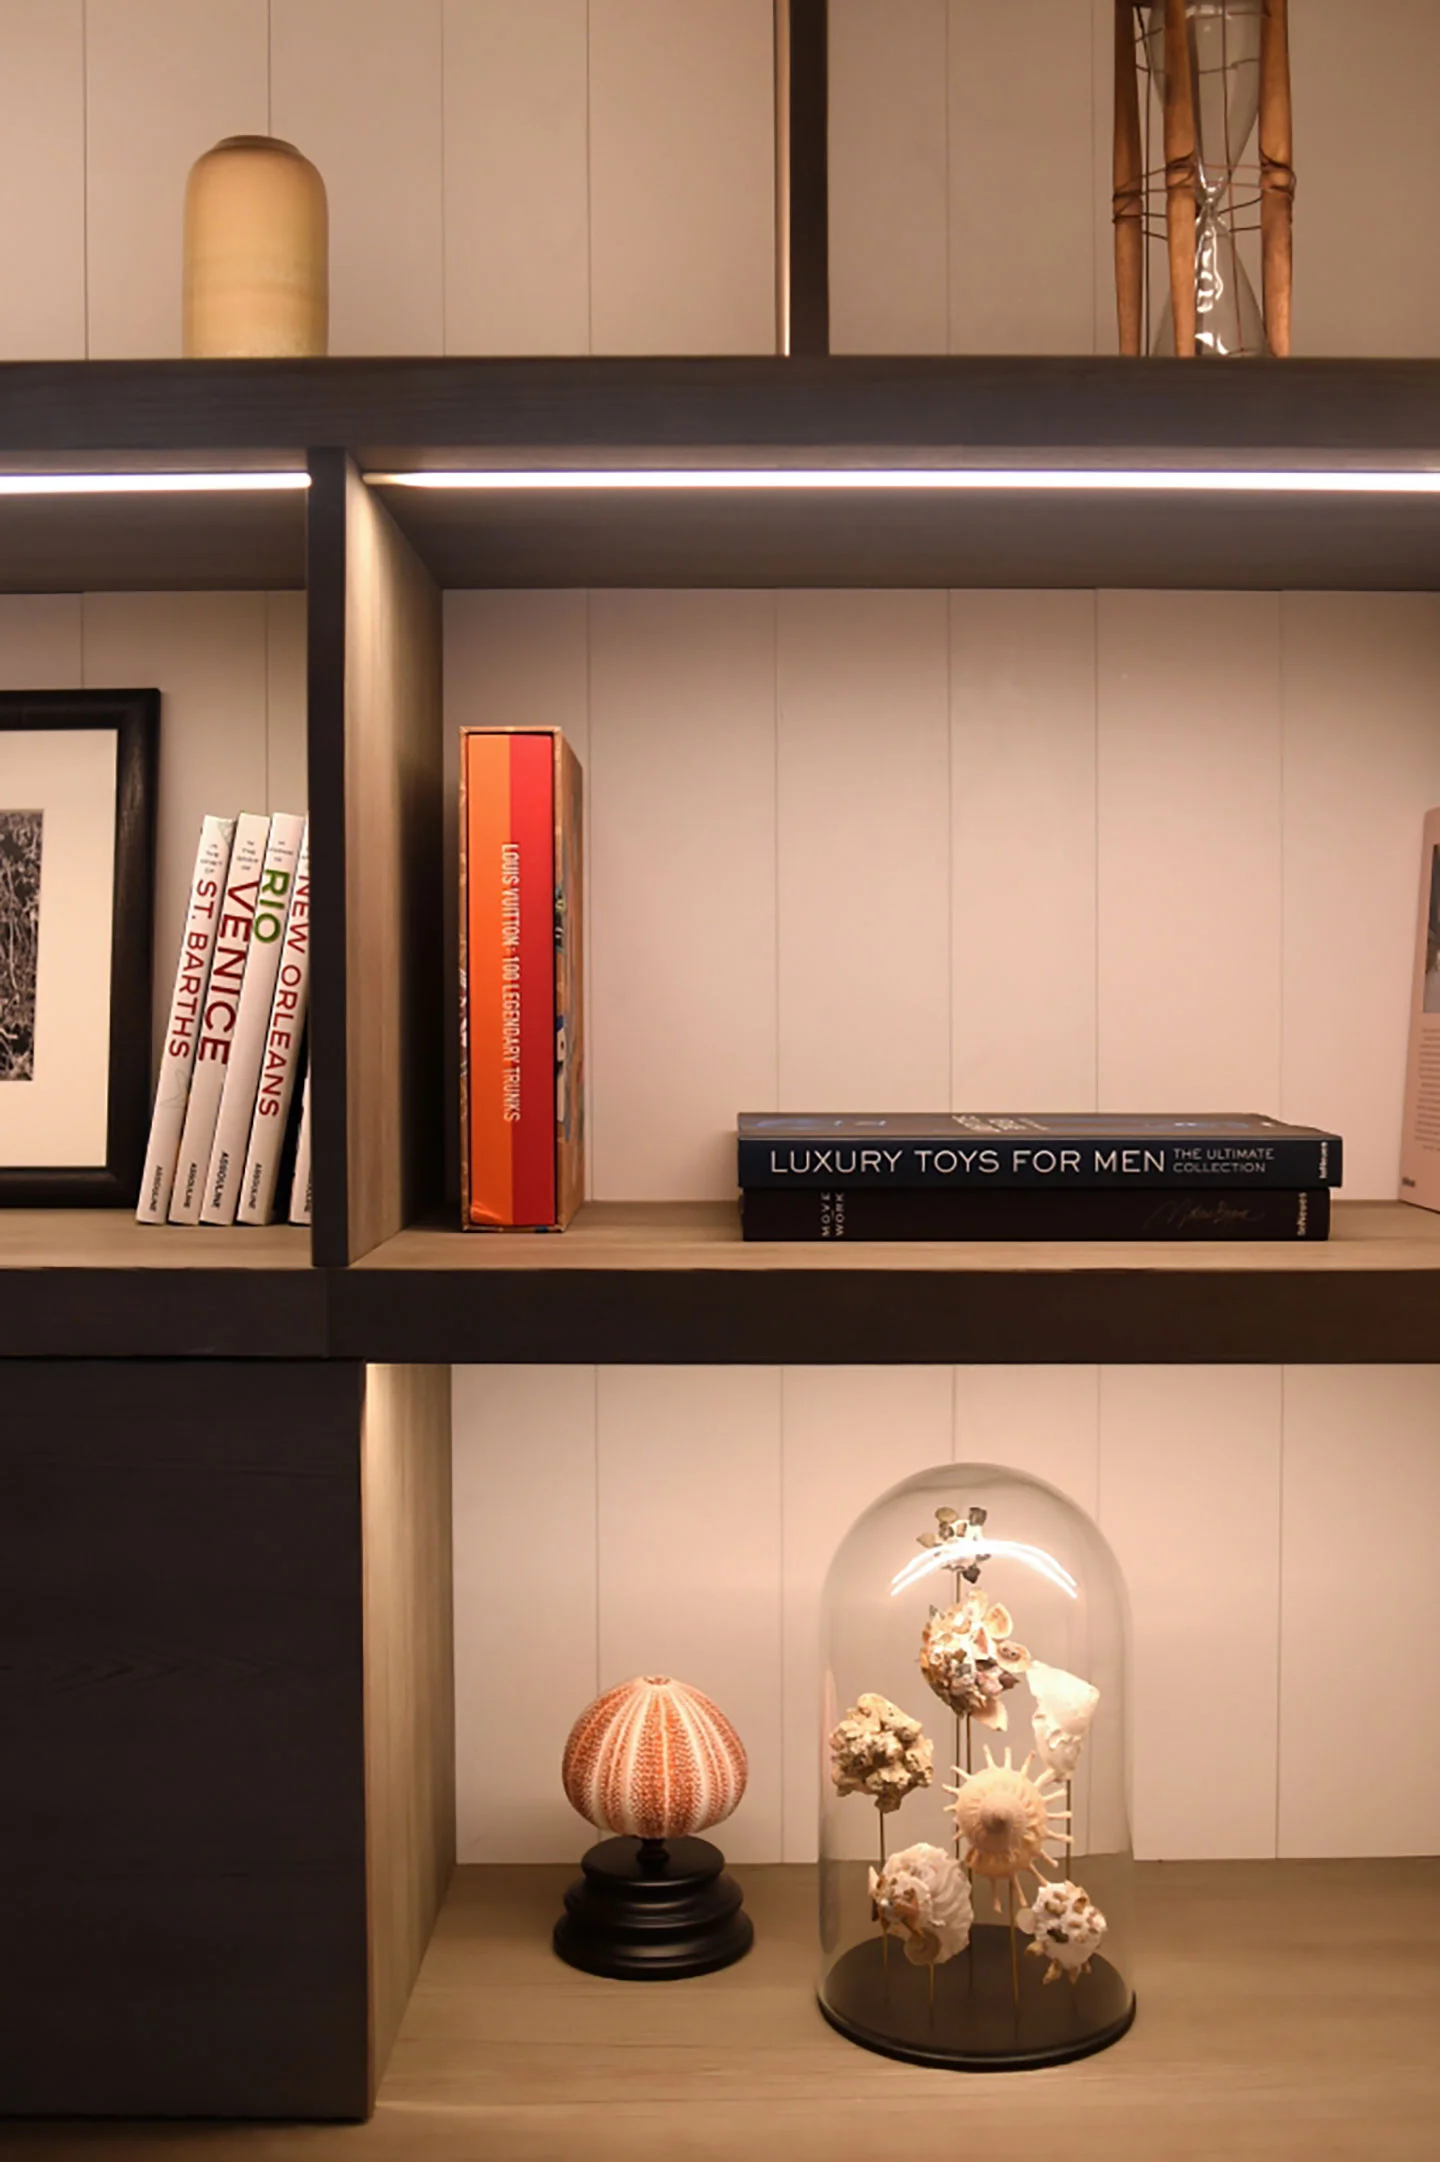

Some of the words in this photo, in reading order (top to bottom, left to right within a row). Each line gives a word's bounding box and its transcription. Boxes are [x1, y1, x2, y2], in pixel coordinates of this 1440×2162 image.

[501, 844, 519, 885] LOUIS
[192, 879, 218, 919] ST.
[254, 868, 290, 943] RIO
[287, 875, 310, 954] NEW
[168, 931, 209, 1058] BARTHS
[198, 880, 259, 1065] VENICE
[501, 956, 520, 981] 100
[259, 965, 301, 1117] ORLEANS
[501, 984, 520, 1063] LEGENDARY
[503, 1066, 520, 1121] TRUNKS
[771, 1149, 902, 1173] LUXURY
[914, 1149, 999, 1173] TOYS
[1012, 1149, 1081, 1173] FOR
[1094, 1149, 1165, 1173] MEN
[1172, 1161, 1266, 1173] COLLECTION
[1173, 1148, 1202, 1160] THE
[1206, 1148, 1275, 1160] ULTIMATE
